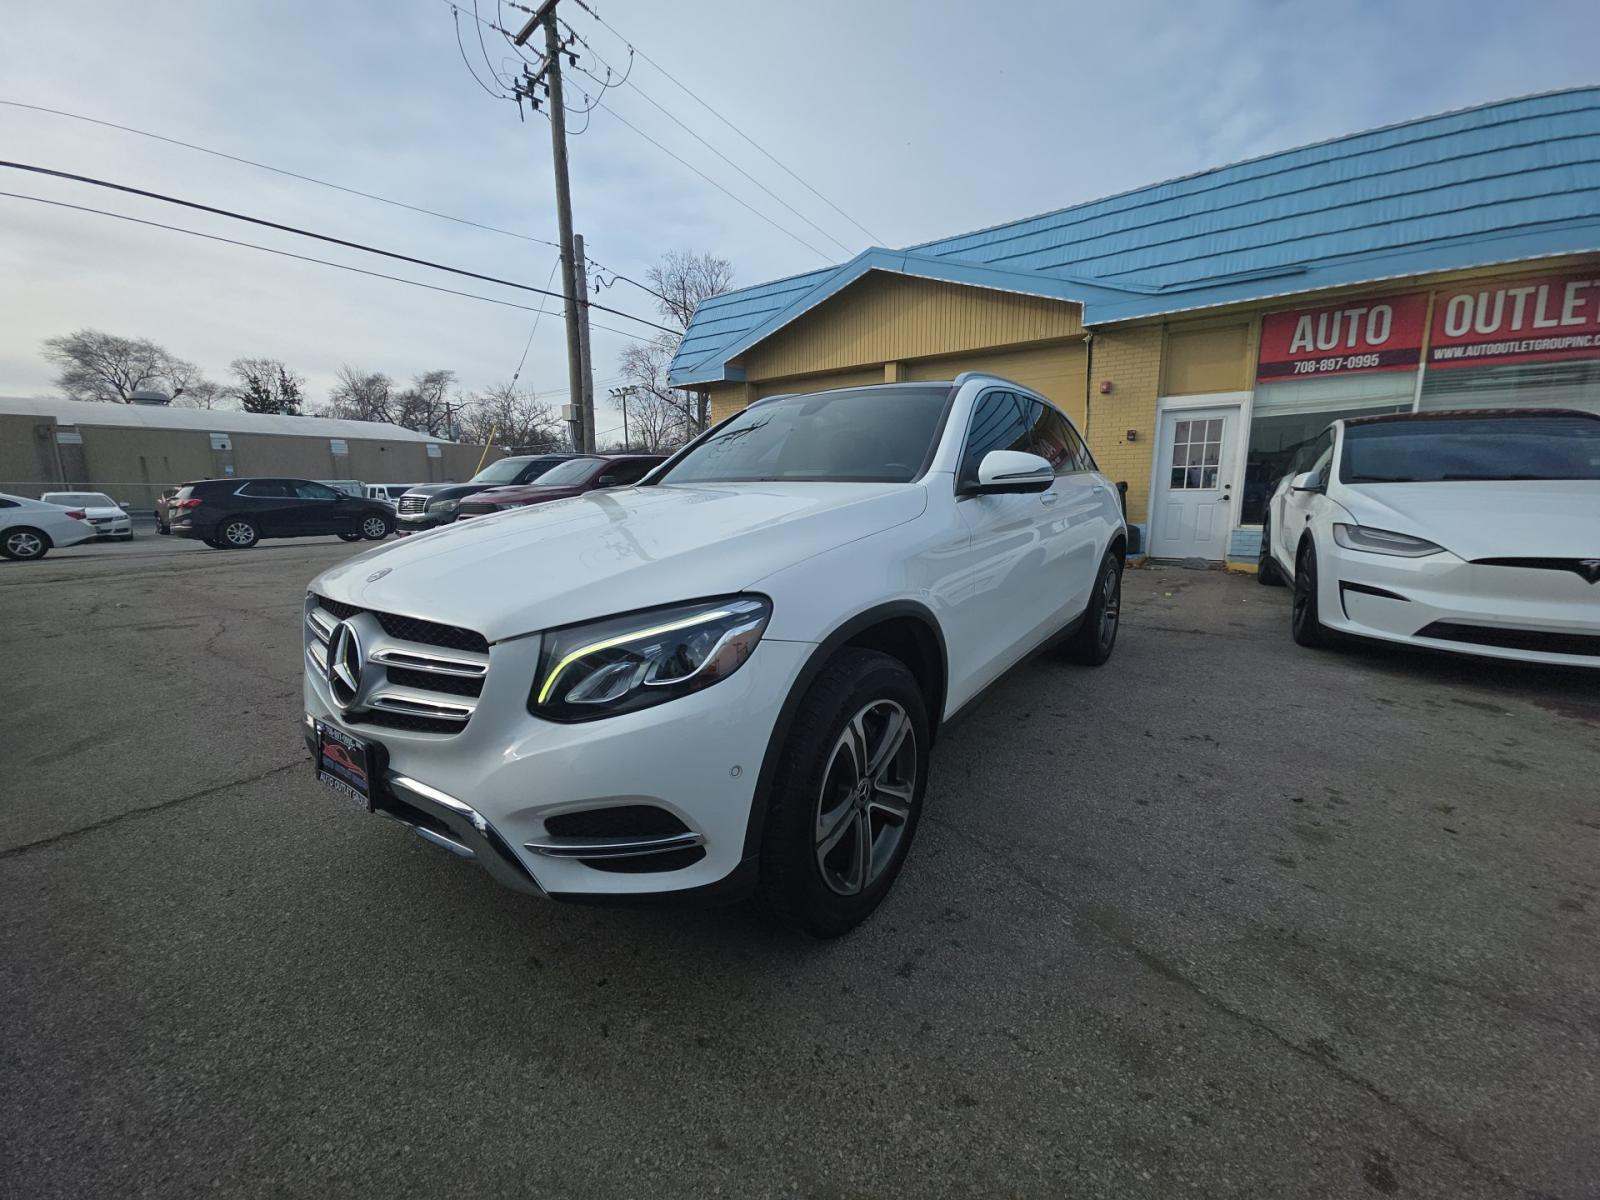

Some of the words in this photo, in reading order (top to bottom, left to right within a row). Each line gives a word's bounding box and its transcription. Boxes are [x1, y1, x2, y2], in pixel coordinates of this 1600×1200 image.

[1289, 304, 1393, 354] AUTO
[1443, 279, 1600, 338] OUTLE
[1293, 353, 1380, 374] 708-897-0995
